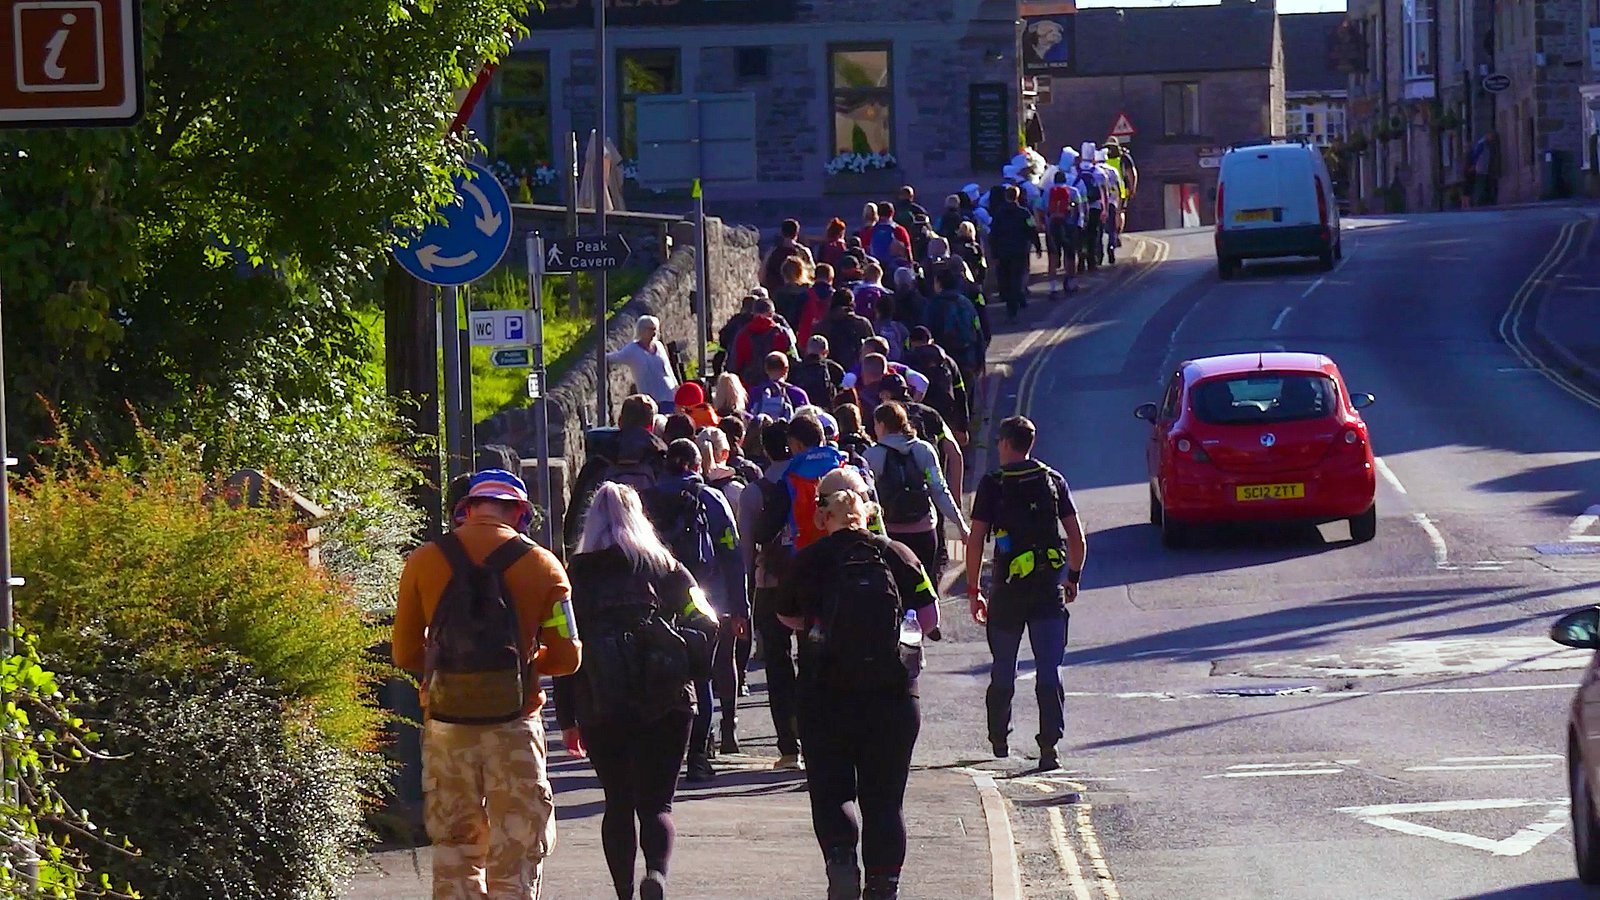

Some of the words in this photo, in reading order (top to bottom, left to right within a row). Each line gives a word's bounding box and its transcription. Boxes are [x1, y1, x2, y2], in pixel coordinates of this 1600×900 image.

[576, 241, 608, 252] Peak
[569, 256, 616, 269] Cavern
[476, 323, 492, 336] WC
[506, 318, 522, 339] P
[1243, 486, 1270, 500] SC12
[1274, 485, 1298, 498] ZTT
